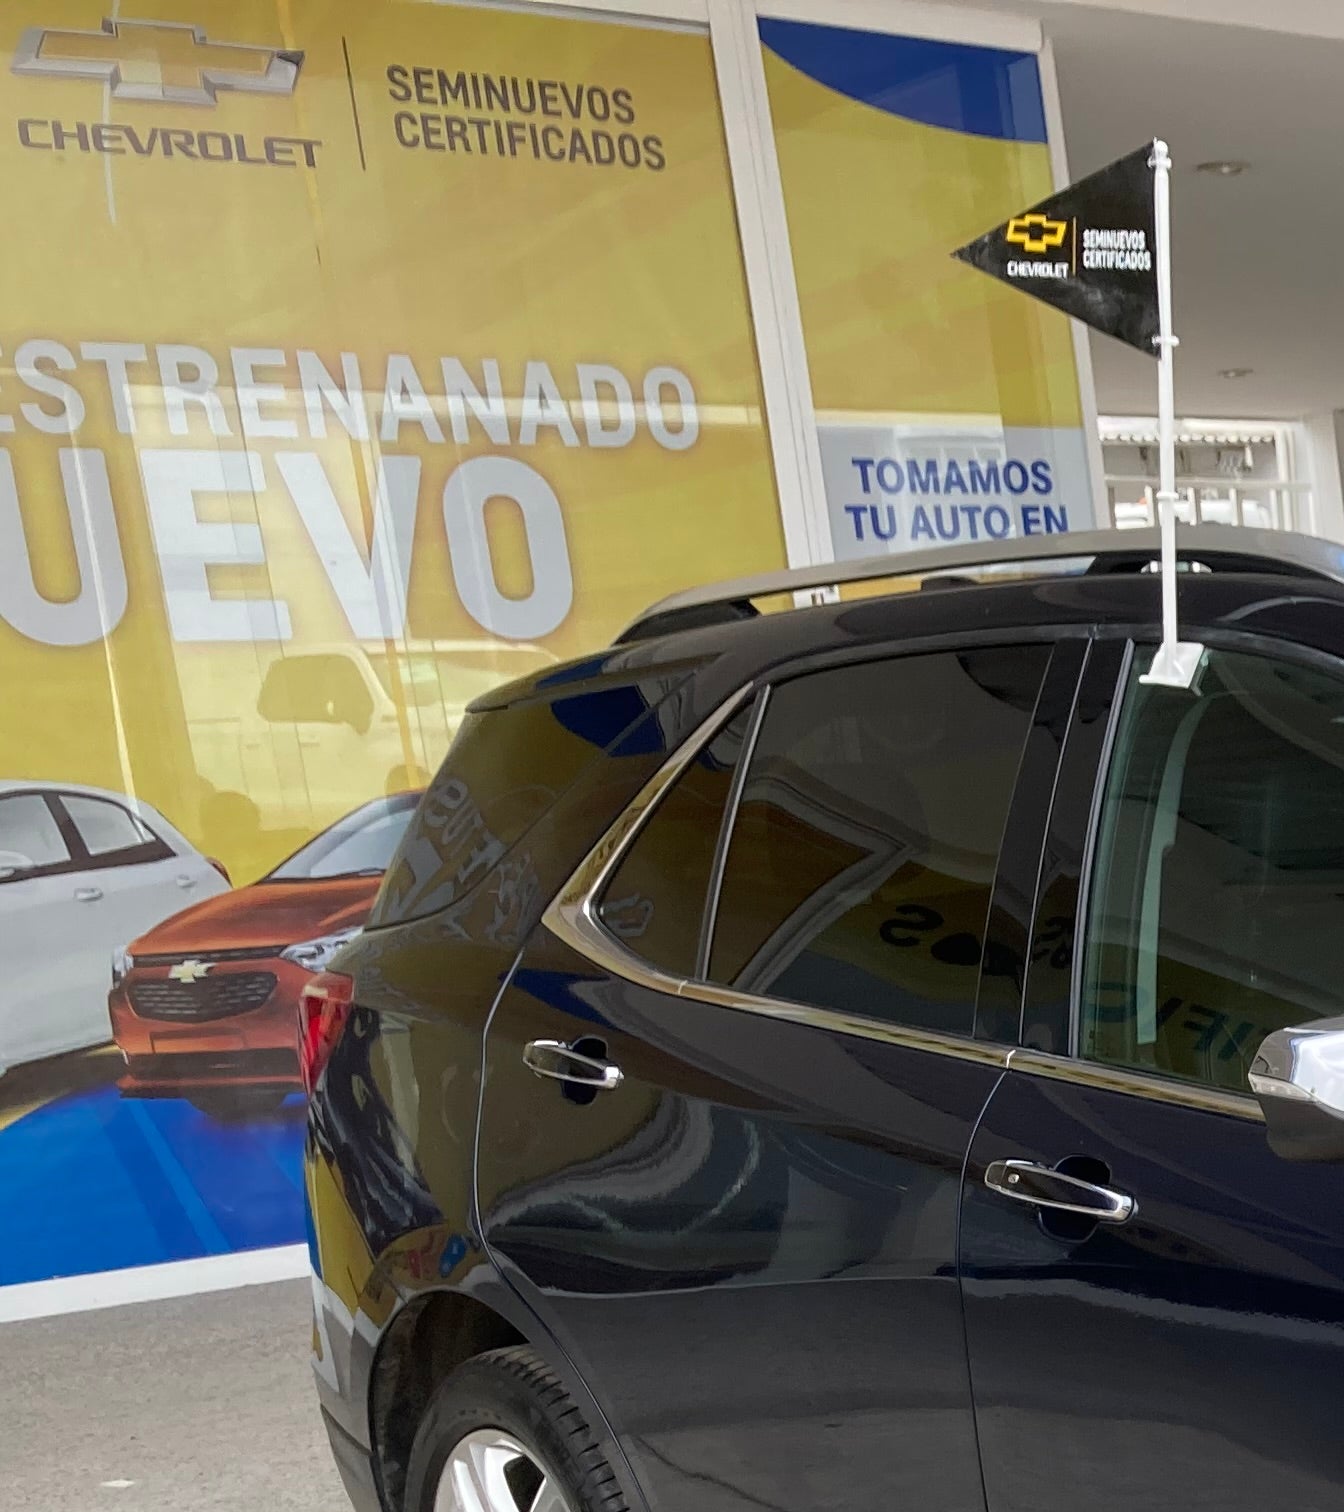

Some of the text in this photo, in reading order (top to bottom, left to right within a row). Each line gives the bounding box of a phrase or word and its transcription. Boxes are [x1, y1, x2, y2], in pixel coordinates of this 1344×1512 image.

[386, 64, 636, 125] SEMINUEVOS
[17, 118, 322, 169] CHEVROLET
[392, 111, 666, 171] CERTIFICADOS
[1083, 229, 1146, 249] SEMINUEVOS
[1007, 260, 1069, 279] CHEVROLET
[1083, 249, 1151, 271] CERTIFICADOS
[0, 339, 699, 450] STRENANADO
[852, 457, 1053, 495] TOMAMOS
[845, 504, 1068, 541] TU AUTO EN
